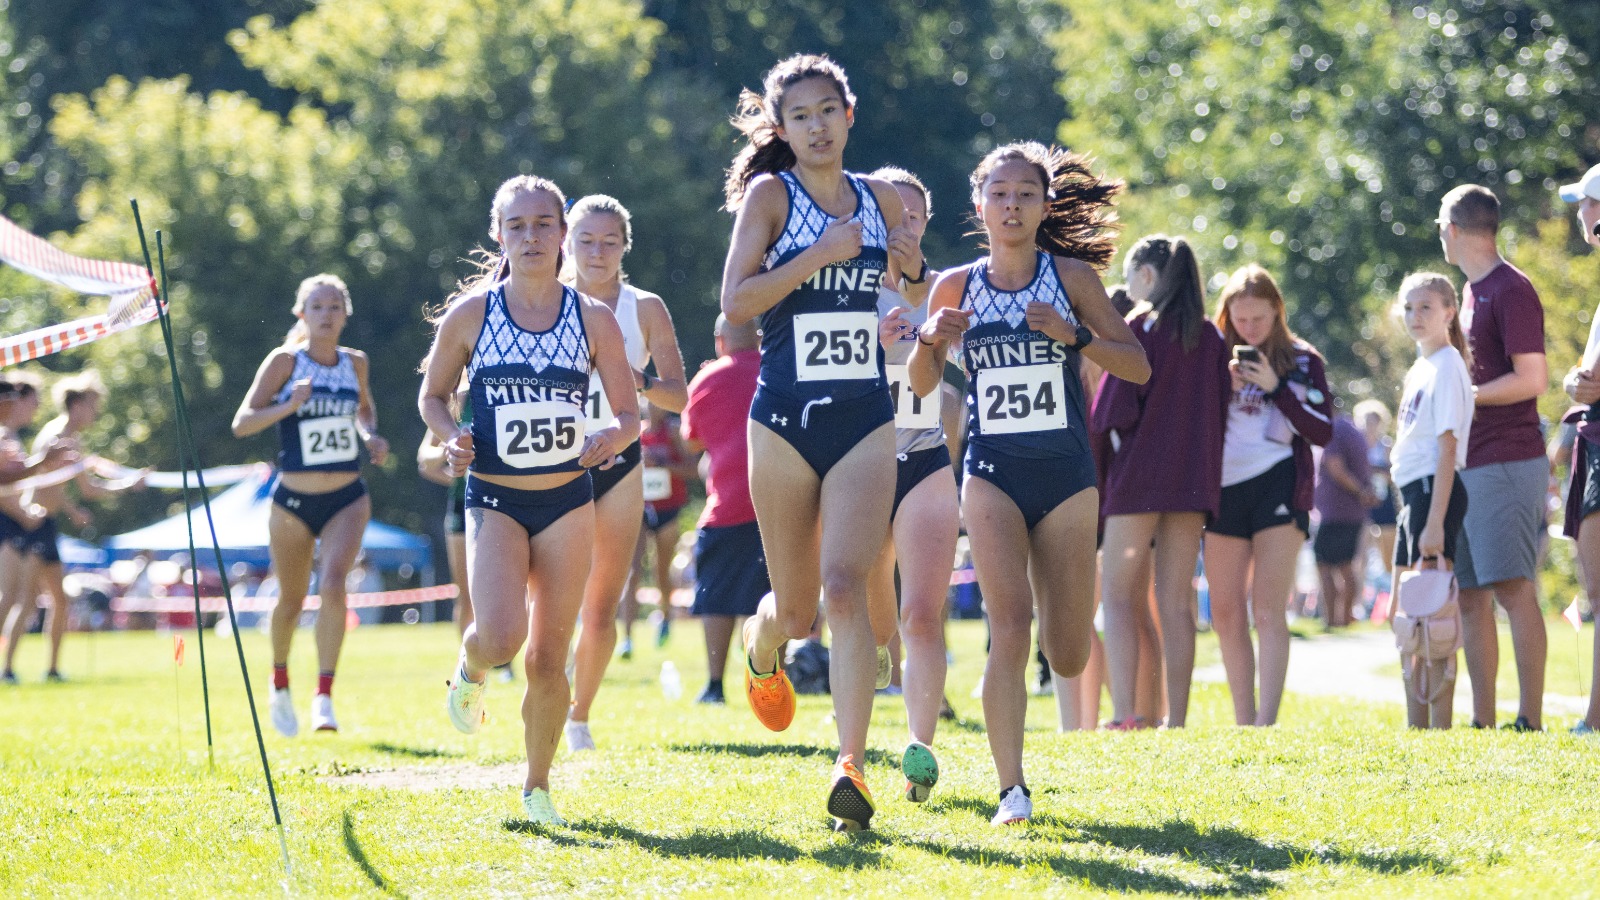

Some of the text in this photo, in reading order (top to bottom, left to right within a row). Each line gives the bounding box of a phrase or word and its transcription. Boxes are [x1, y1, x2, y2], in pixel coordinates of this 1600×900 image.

[804, 329, 870, 366] 253
[968, 341, 1067, 370] MINES
[985, 381, 1057, 420] 254
[308, 428, 351, 453] 245
[505, 416, 576, 455] 255
